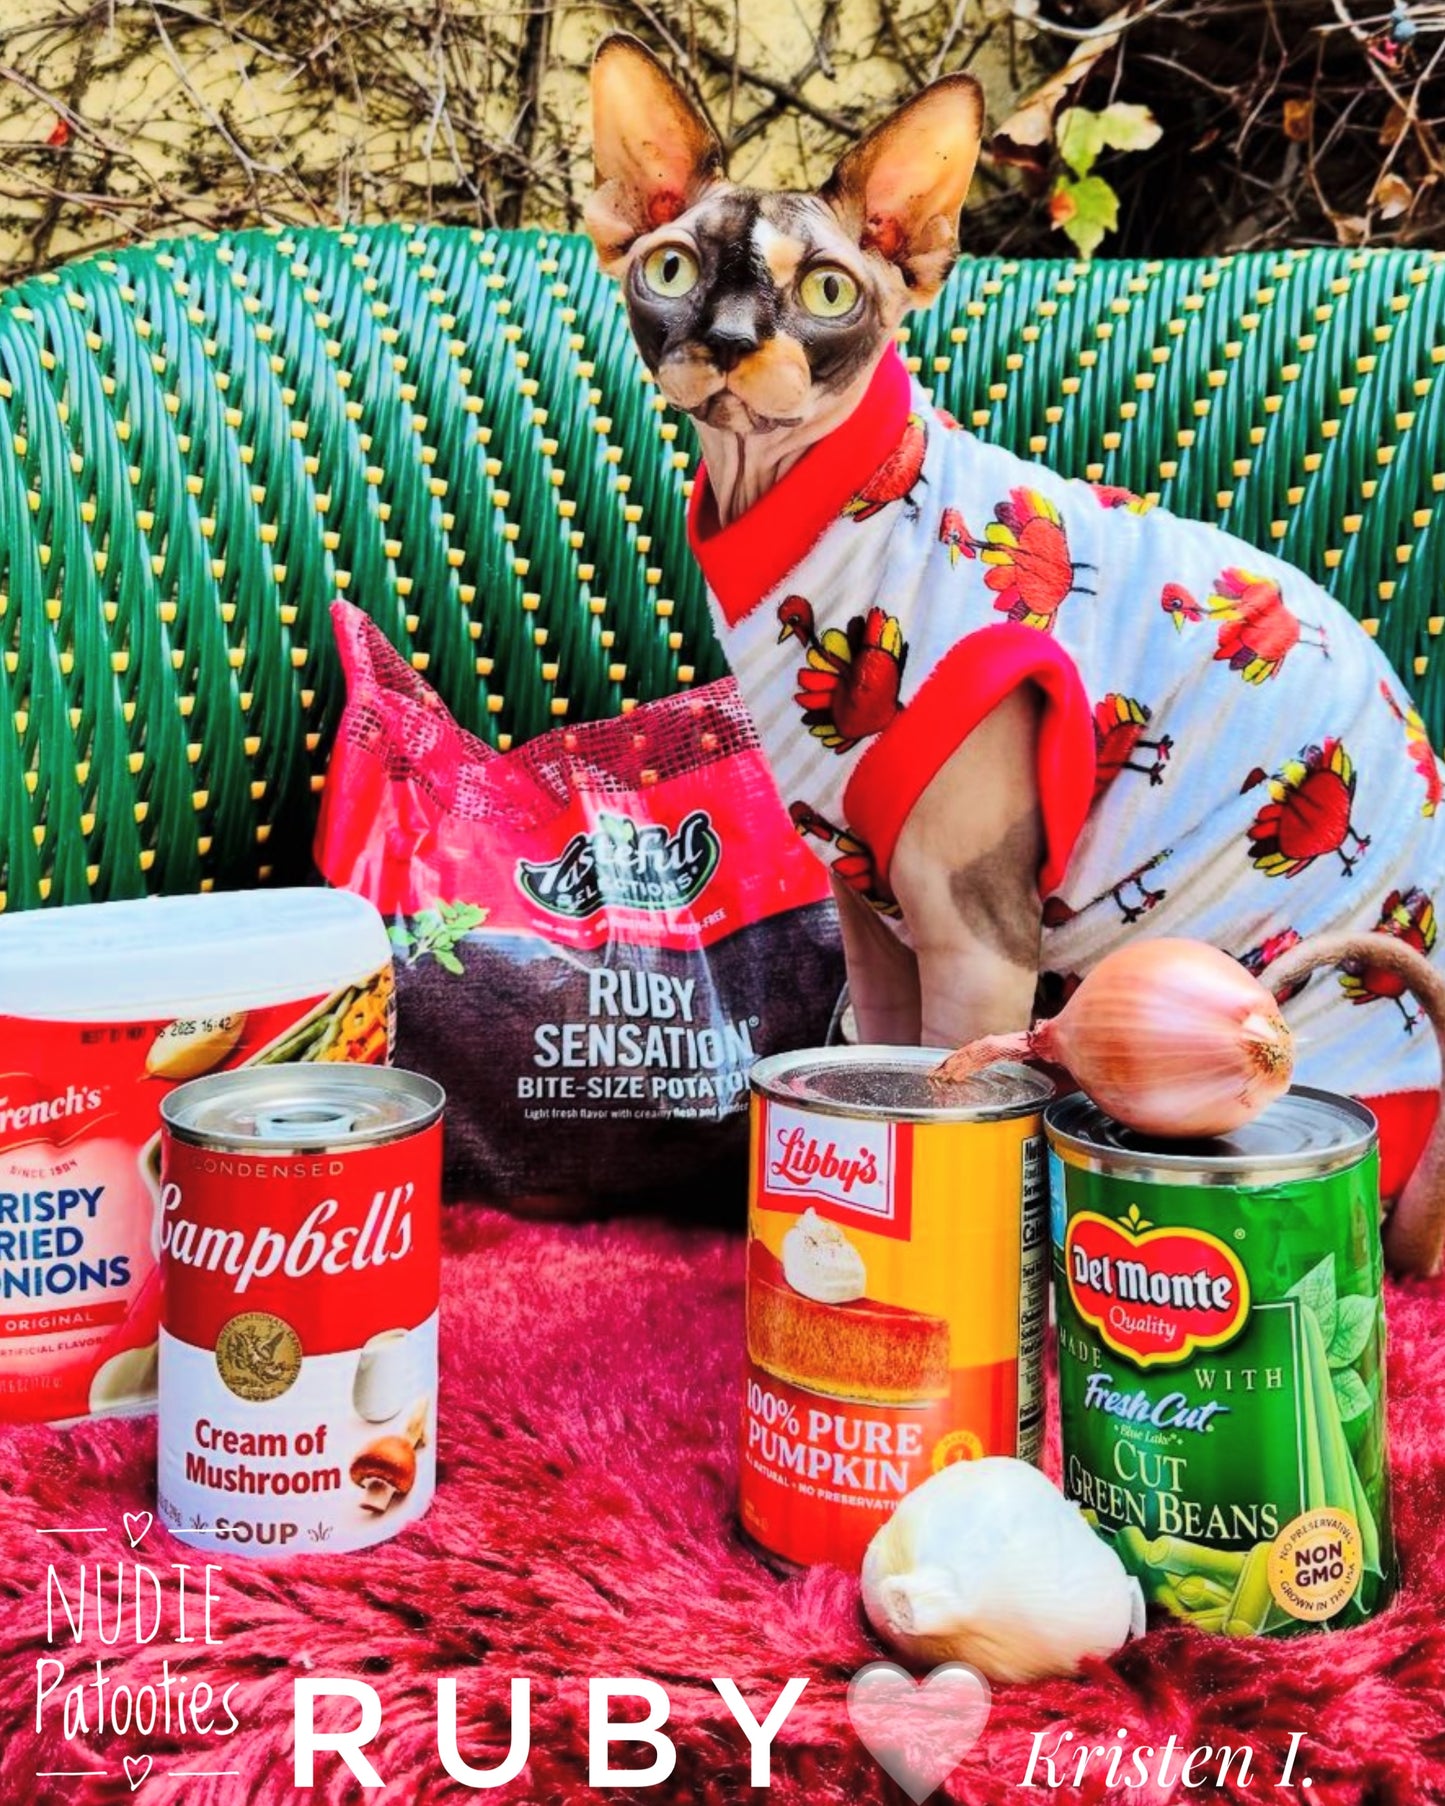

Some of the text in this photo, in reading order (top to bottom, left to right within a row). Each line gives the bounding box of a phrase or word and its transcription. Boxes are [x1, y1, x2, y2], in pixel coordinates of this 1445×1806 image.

[523, 818, 703, 895] Tasteful
[589, 968, 695, 1021] RUBY
[534, 1019, 754, 1069] SENSATION
[517, 1071, 751, 1099] BITE-SIZE POTATO
[0, 1084, 102, 1134] rench's
[552, 1108, 577, 1119] fresh
[580, 1108, 608, 1119] flavor
[611, 1109, 632, 1119] with
[634, 1109, 672, 1121] creamy
[771, 1127, 877, 1193] Libby's
[0, 1186, 105, 1223] RISPY
[0, 1226, 84, 1261] RIED
[160, 1182, 414, 1293] Campbell's
[0, 1255, 131, 1299] NIONS
[1073, 1244, 1113, 1295] Del
[1116, 1259, 1233, 1311] Monte
[5, 1312, 94, 1332] ORIGINAL
[1109, 1305, 1176, 1343] Quality
[0, 1336, 109, 1358] RTIFICIAL FLAVOR
[1194, 1367, 1283, 1391] WITH
[747, 1378, 923, 1457] 100% PURE
[195, 1418, 327, 1457] Cream of
[749, 1417, 910, 1493] PUMPKIN
[186, 1451, 342, 1496] Mushroom
[1113, 1438, 1187, 1492] CUT
[798, 1483, 816, 1497] NO
[1069, 1454, 1280, 1540] GREEN BEANS
[215, 1517, 298, 1545] SOUP
[1295, 1540, 1342, 1567] NON
[1295, 1561, 1344, 1587] GMO
[1280, 1580, 1314, 1611] GROWN
